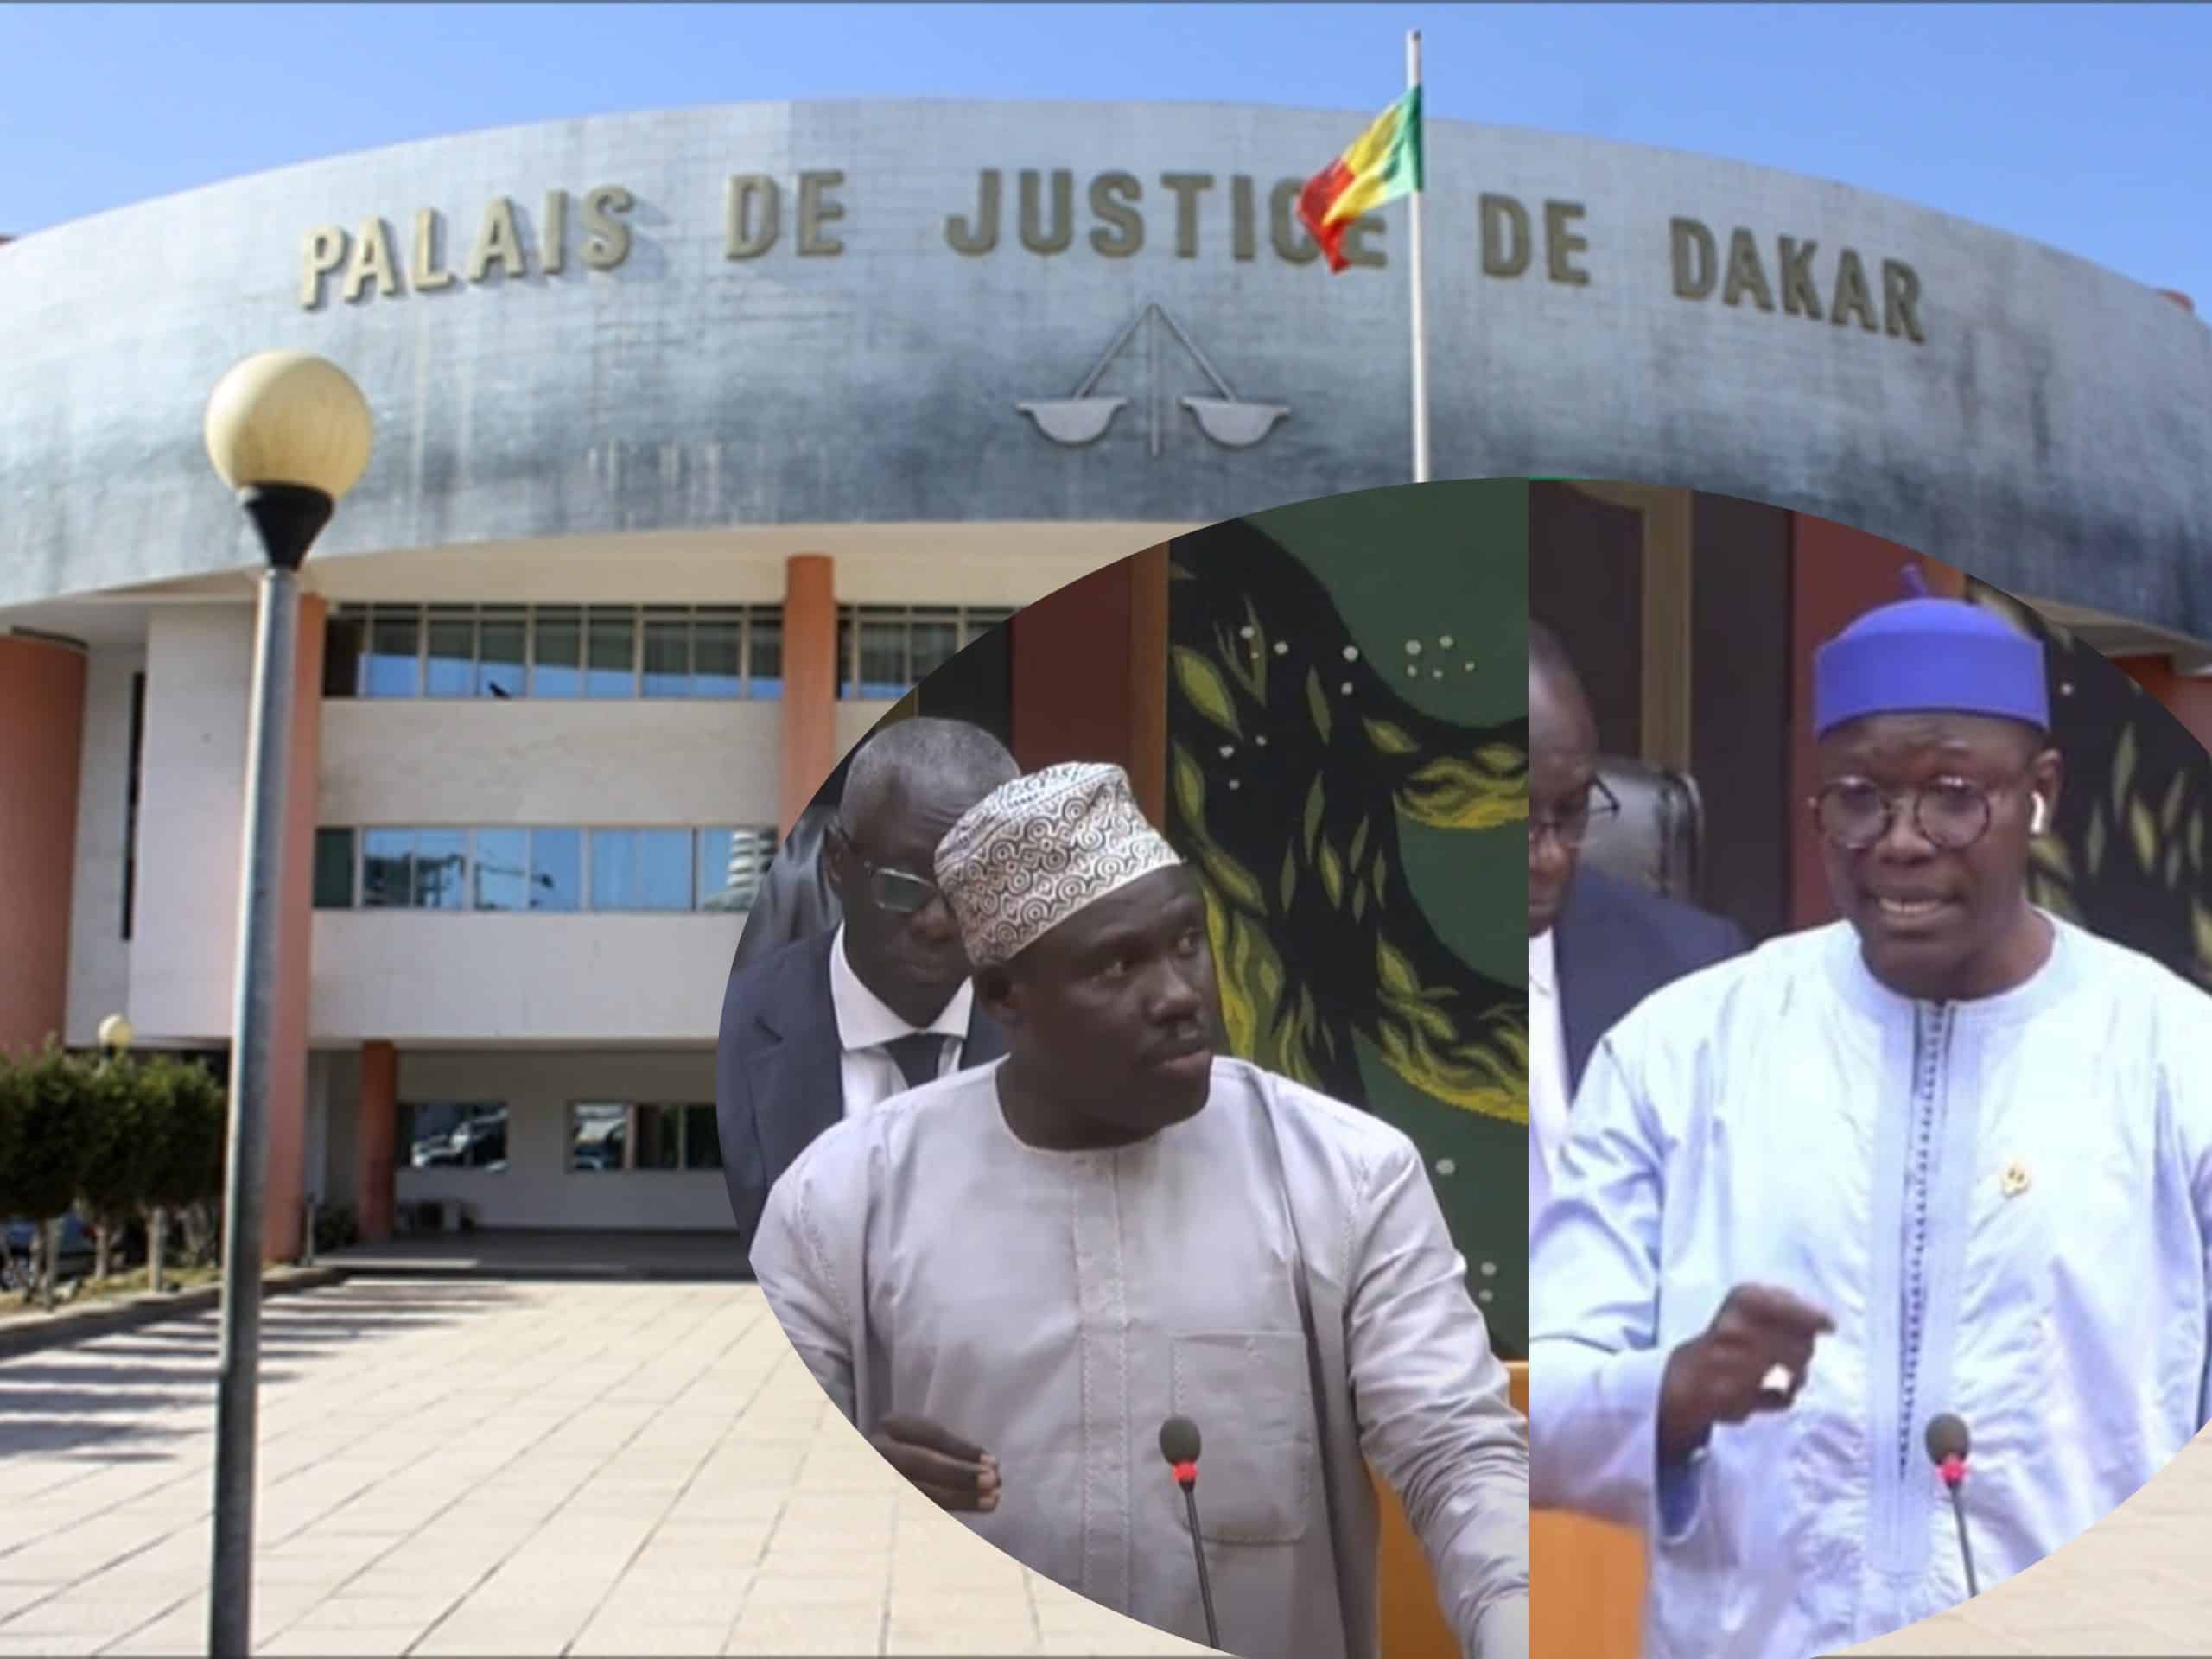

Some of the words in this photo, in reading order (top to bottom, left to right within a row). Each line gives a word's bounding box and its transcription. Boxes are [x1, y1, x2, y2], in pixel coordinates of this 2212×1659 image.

[300, 185, 635, 310] PALAIS
[726, 170, 846, 260] DE
[1478, 193, 1591, 287] DE
[1669, 217, 1926, 344] DAKAR
